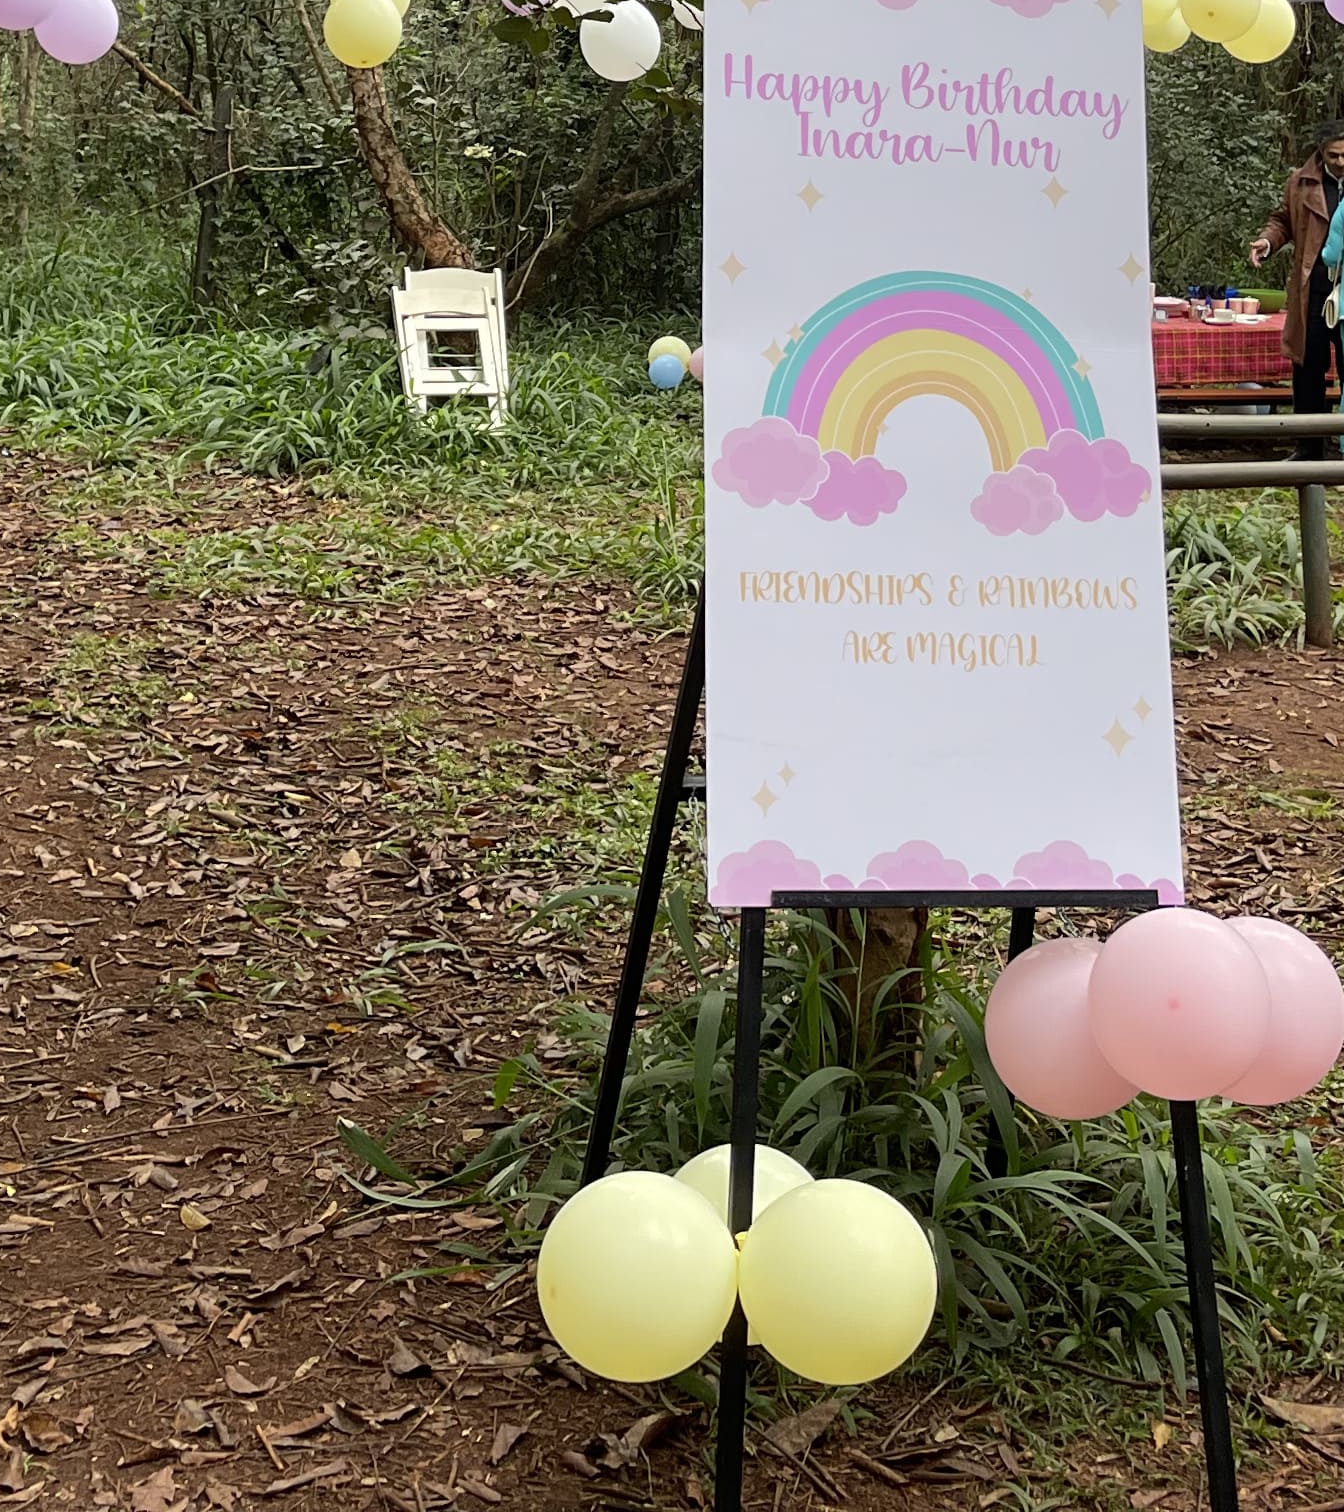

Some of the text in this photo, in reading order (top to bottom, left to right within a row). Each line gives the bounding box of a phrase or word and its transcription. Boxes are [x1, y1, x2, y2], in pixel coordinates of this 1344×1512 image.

[723, 53, 1130, 140] Happy Birthday
[797, 110, 1061, 172] Inara-Nur
[739, 570, 1138, 610] FRIENDSHIPS & RAINBOWS
[842, 629, 1047, 672] ARE MAGICAL
